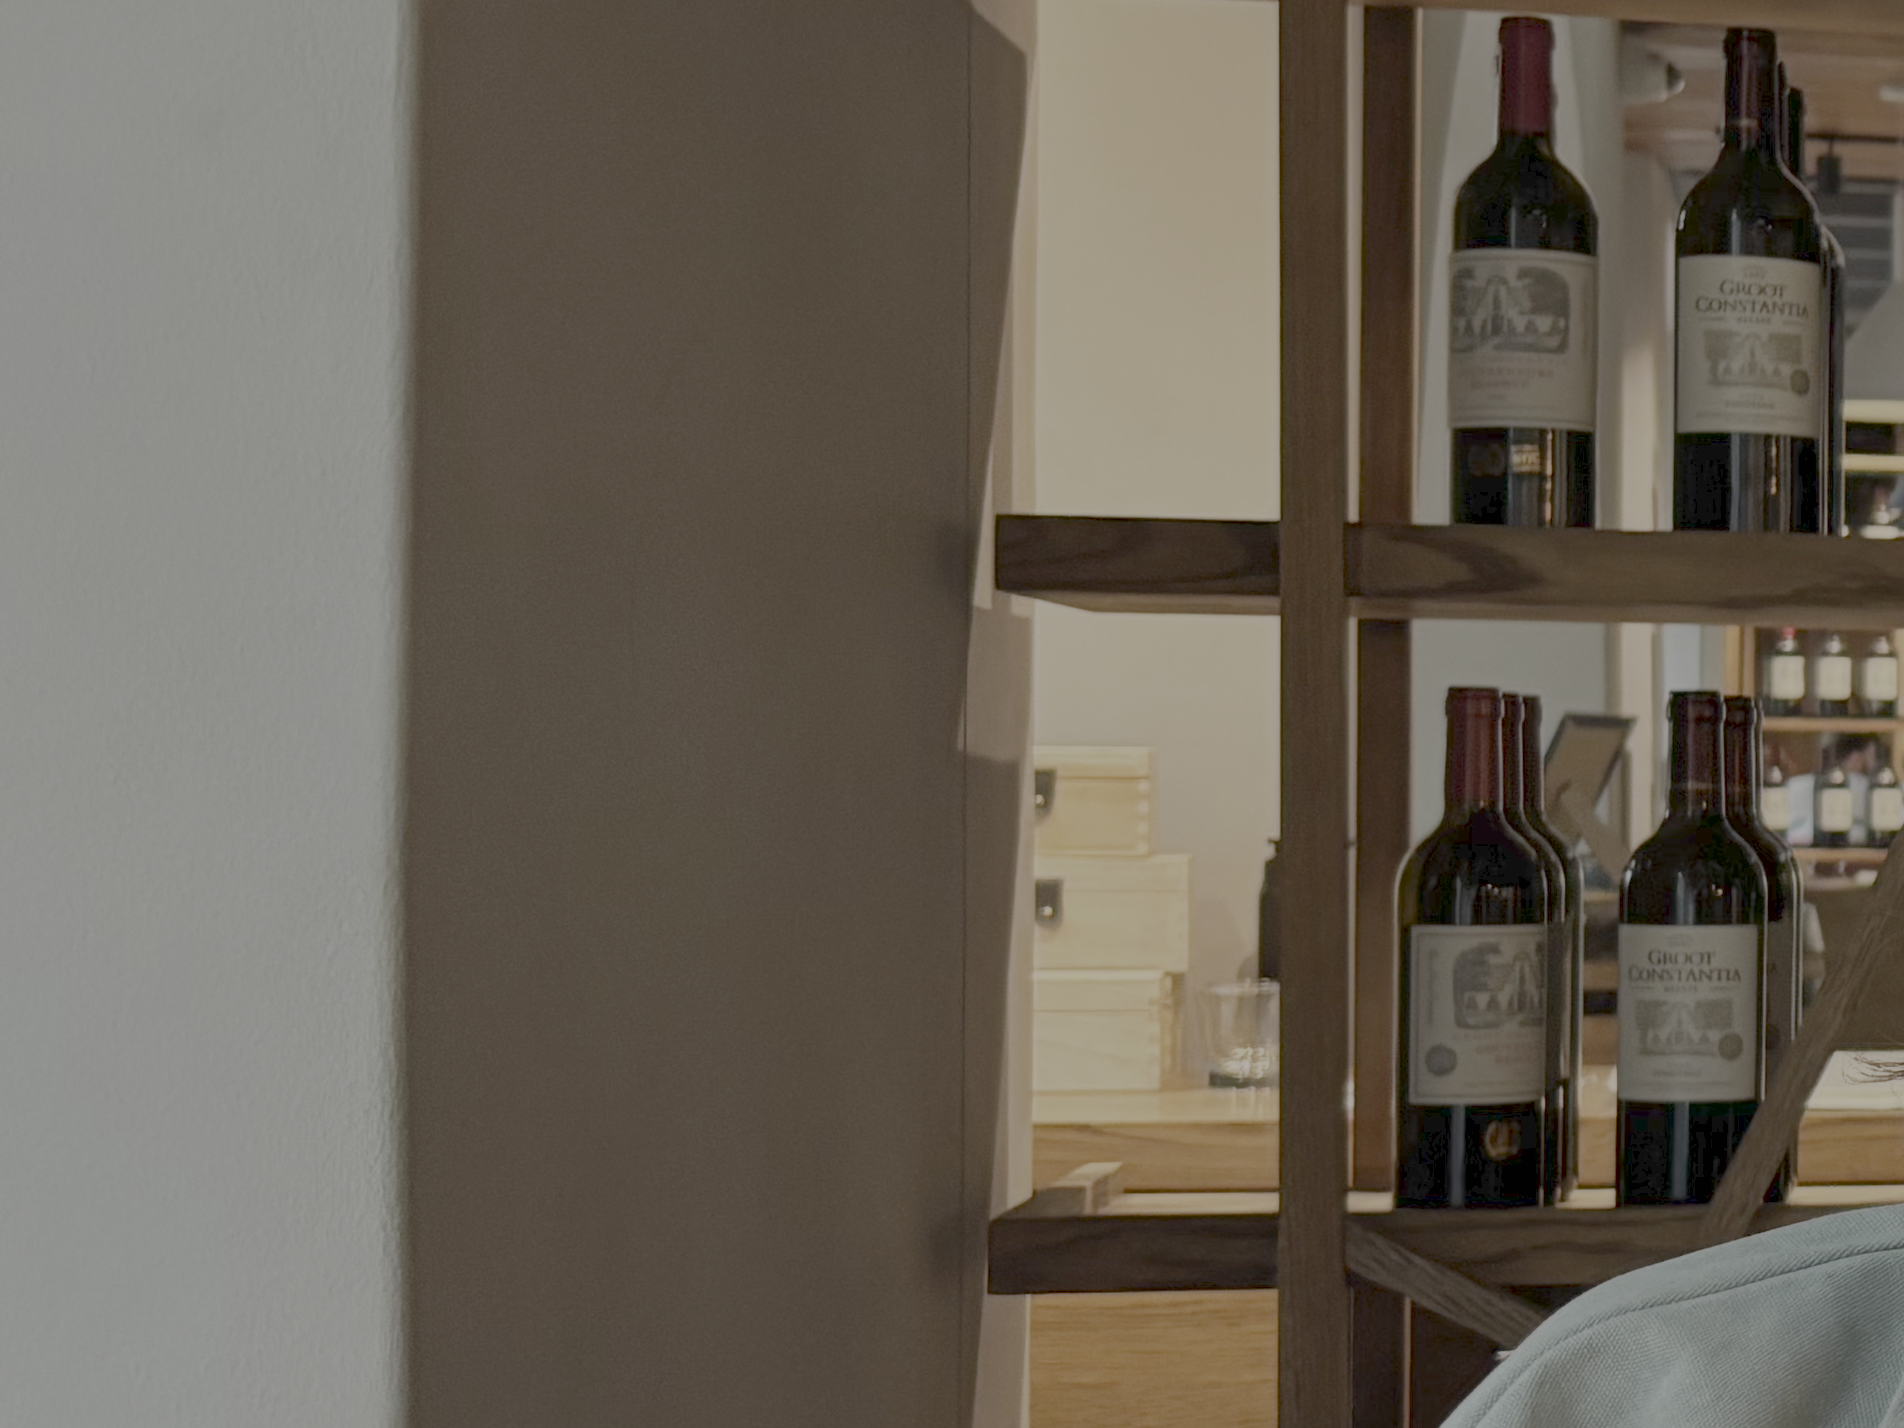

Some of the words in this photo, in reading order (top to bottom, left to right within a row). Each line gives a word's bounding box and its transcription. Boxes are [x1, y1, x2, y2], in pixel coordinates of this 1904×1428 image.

[1720, 280, 1787, 299] GROOT
[1696, 297, 1810, 319] CONSTANTIA
[1648, 949, 1717, 966] GROOT
[1628, 965, 1743, 983] CONSTANTIA
